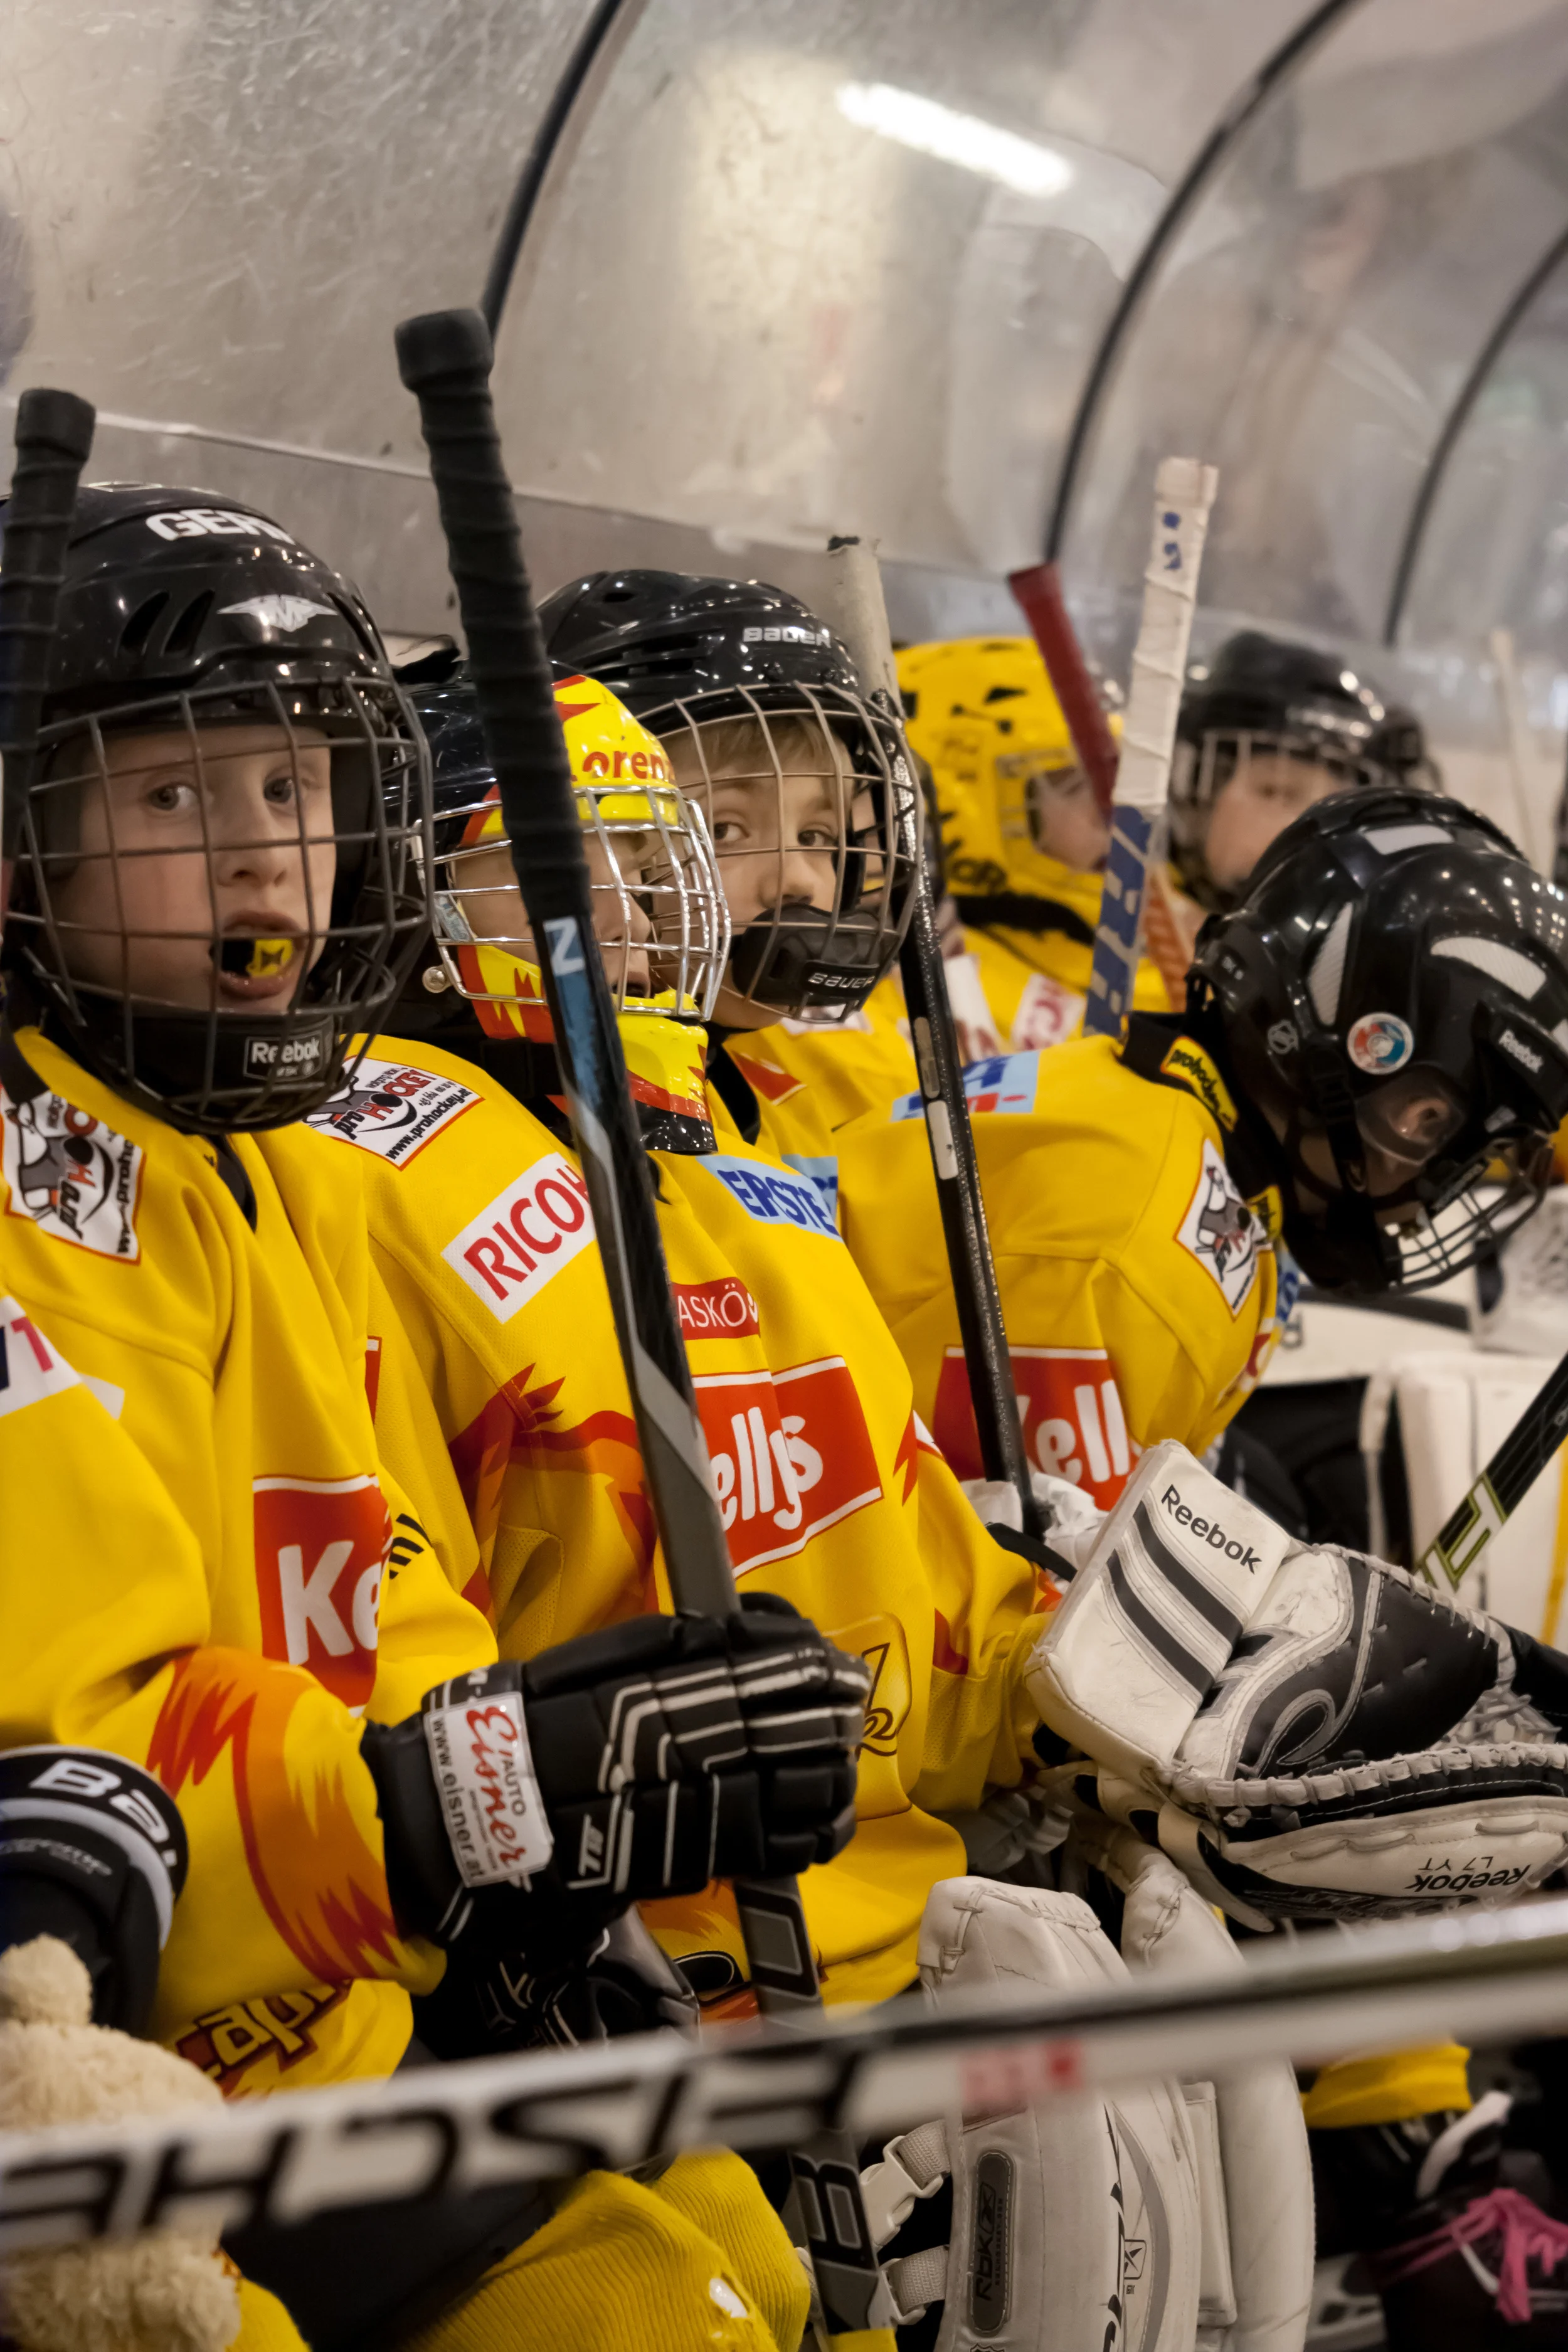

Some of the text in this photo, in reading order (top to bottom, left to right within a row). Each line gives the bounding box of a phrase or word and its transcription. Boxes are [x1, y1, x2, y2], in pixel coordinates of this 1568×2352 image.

[570, 750, 677, 783] oren
[385, 1088, 474, 1160] www.prohockey.at
[716, 1169, 840, 1236] ERSTE
[708, 1406, 824, 1532] ellys
[1160, 1483, 1263, 1576] Reebok
[501, 1759, 526, 1816] AUTO
[1404, 1863, 1532, 1893] Reebok
